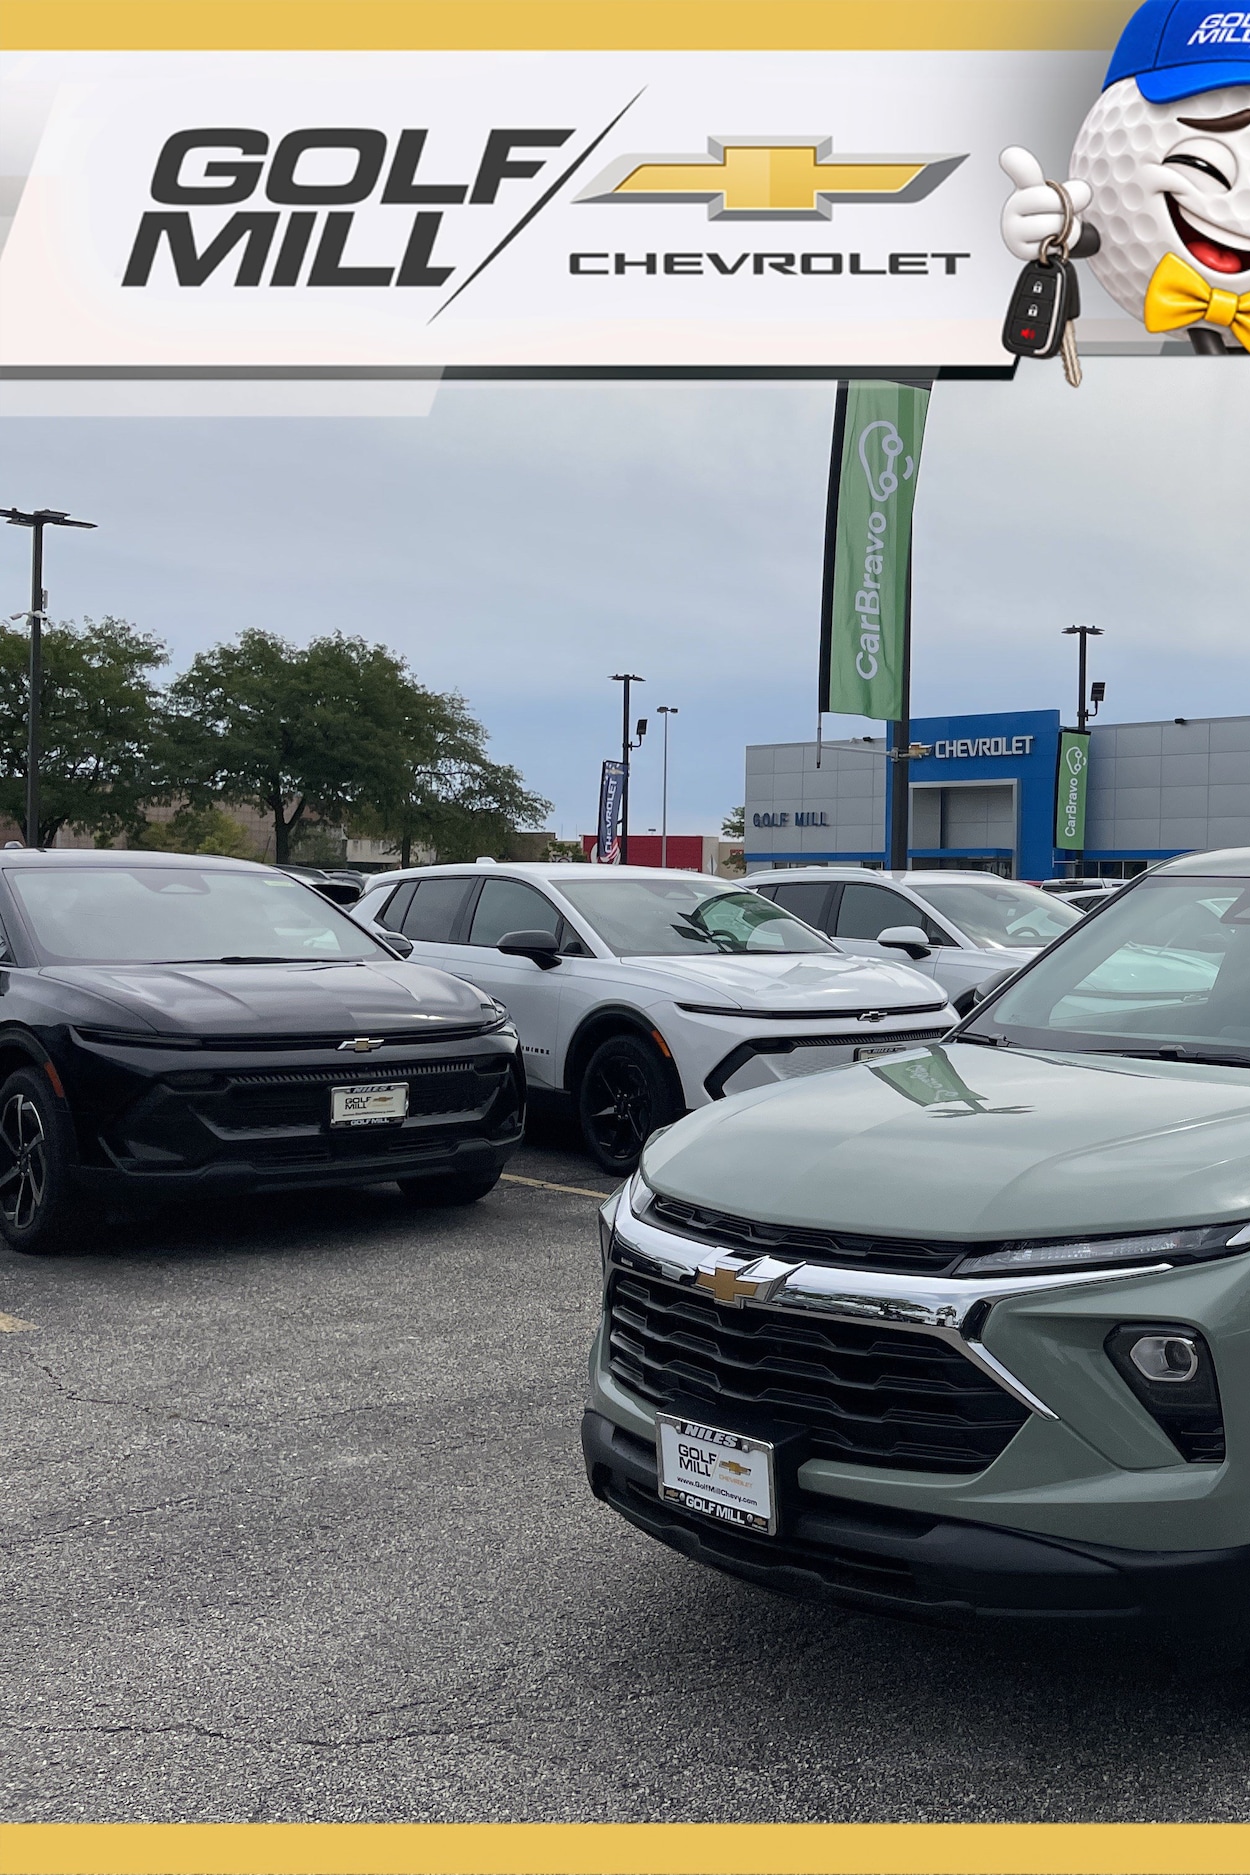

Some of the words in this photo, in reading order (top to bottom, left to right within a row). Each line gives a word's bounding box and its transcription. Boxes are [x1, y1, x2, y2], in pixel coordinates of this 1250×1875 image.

[855, 511, 887, 681] CarBravo
[935, 735, 1035, 759] CHEVROLET
[605, 778, 617, 854] CHEVROLET
[1064, 778, 1078, 837] CarBravo
[753, 812, 789, 828] GOLF
[795, 811, 829, 827] MILL
[345, 1096, 372, 1105] GOLF
[345, 1102, 367, 1110] MILL
[350, 1118, 371, 1126] GOLF
[684, 1424, 738, 1448] NILES
[678, 1443, 717, 1465] GOLF
[679, 1456, 711, 1478] MILL
[685, 1494, 716, 1515] GOLF
[715, 1504, 745, 1525] MILL
